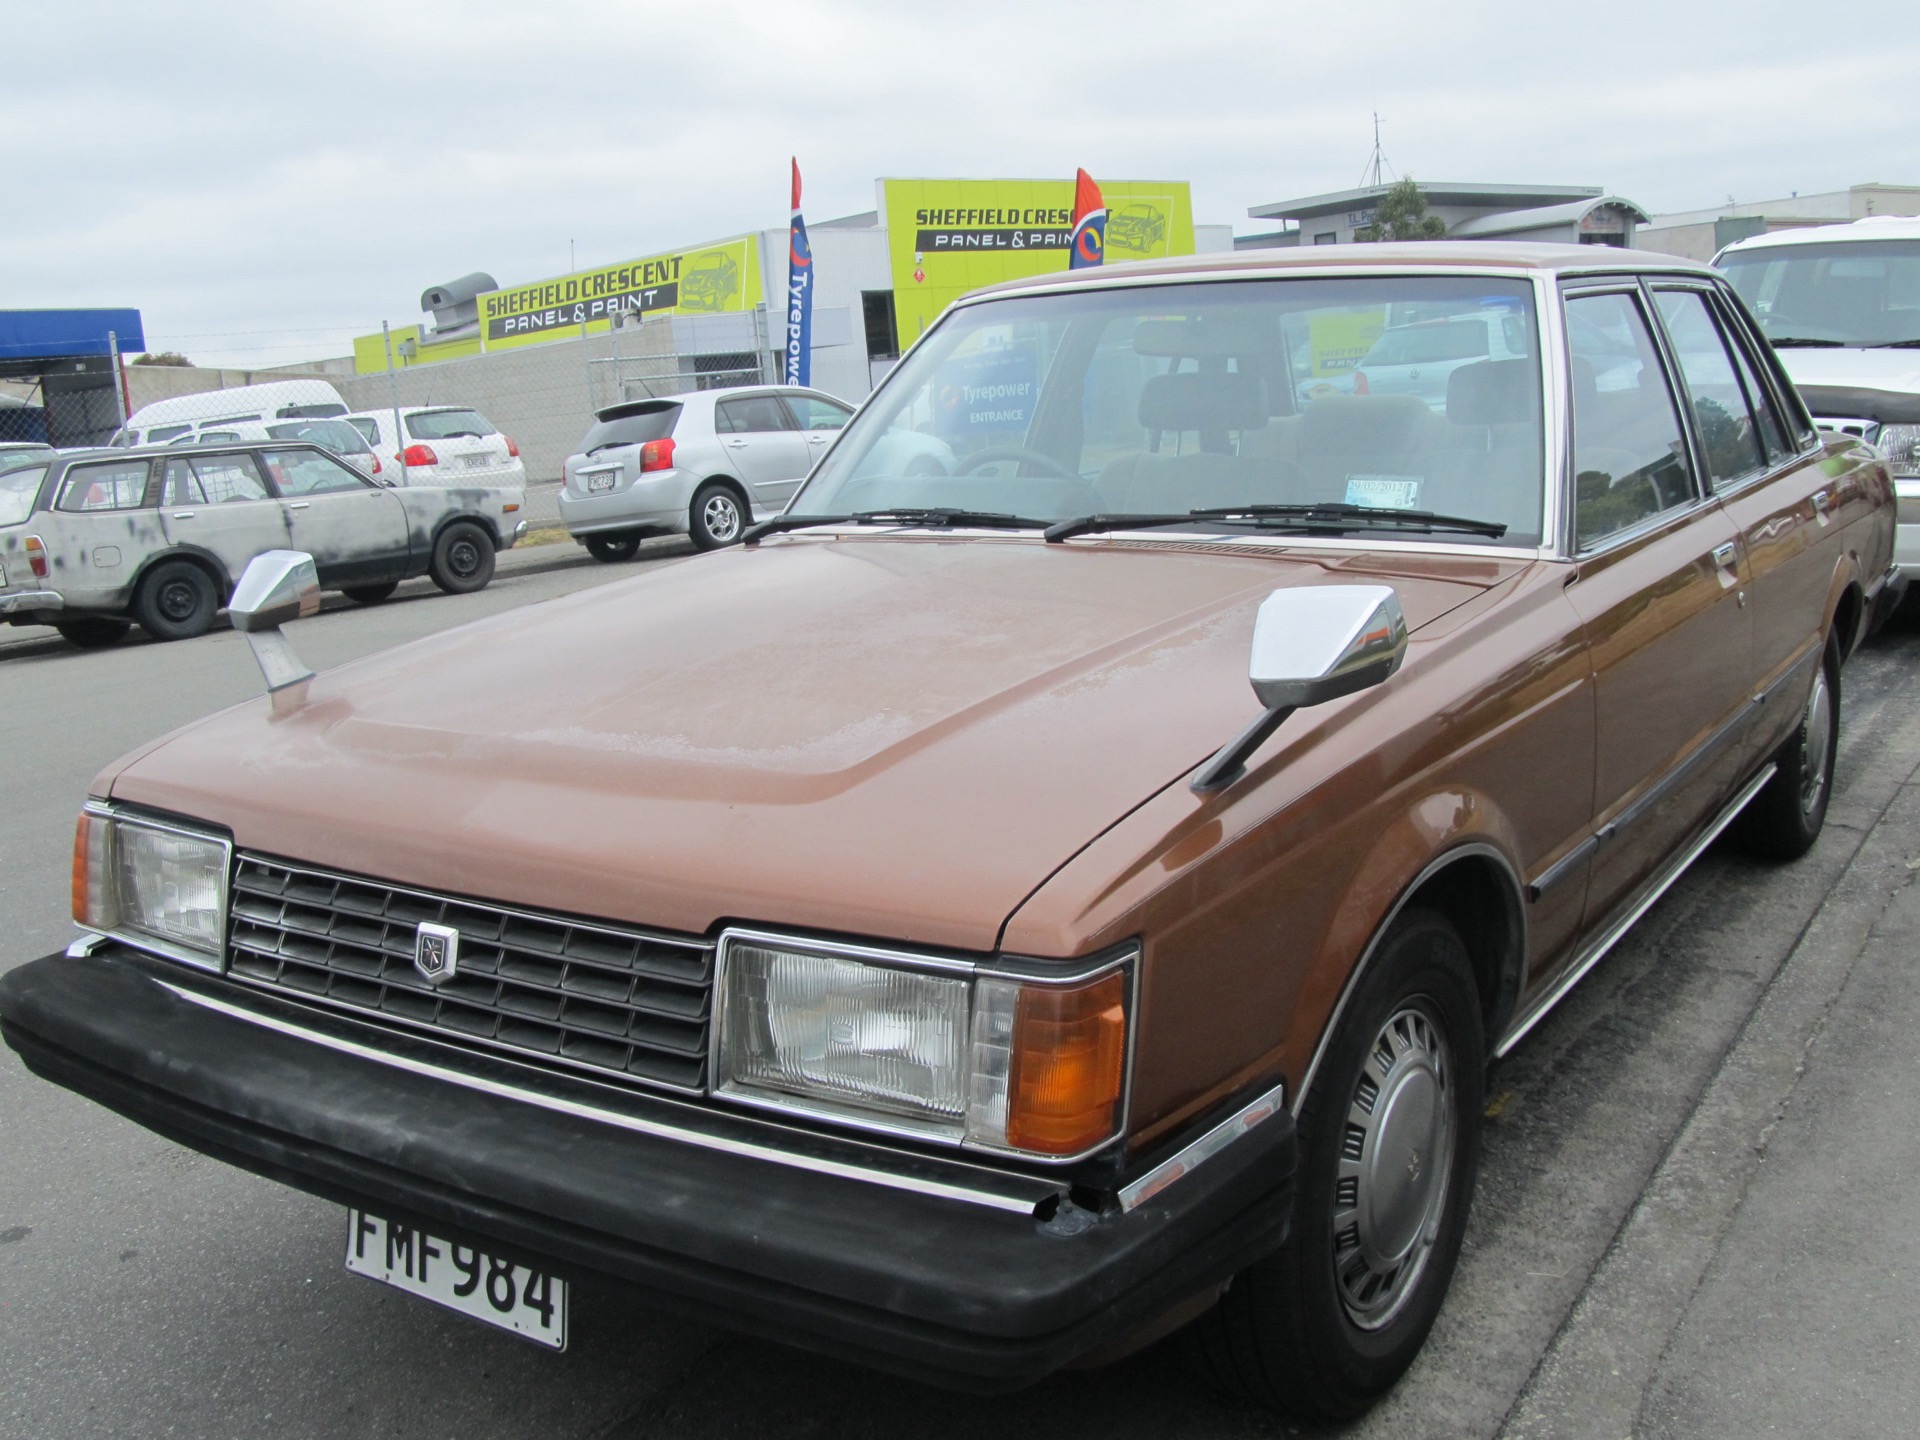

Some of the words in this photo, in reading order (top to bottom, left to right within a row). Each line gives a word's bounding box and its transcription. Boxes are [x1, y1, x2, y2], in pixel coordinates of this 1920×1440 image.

[916, 208, 1020, 226] SHEFFIELD
[935, 233, 1007, 247] PANEL
[1011, 231, 1026, 248] &
[1030, 233, 1074, 246] PAIN
[486, 280, 578, 318] SHEFFIELD
[581, 256, 683, 298] CRESCENT
[505, 309, 568, 333] PANEL
[573, 303, 587, 323] &
[591, 289, 658, 317] PAINT
[787, 272, 808, 387] Tyrepowe
[962, 382, 1031, 405] Tyrepower
[969, 409, 1024, 424] ENTRANCE
[355, 1210, 555, 1330] FMF984
